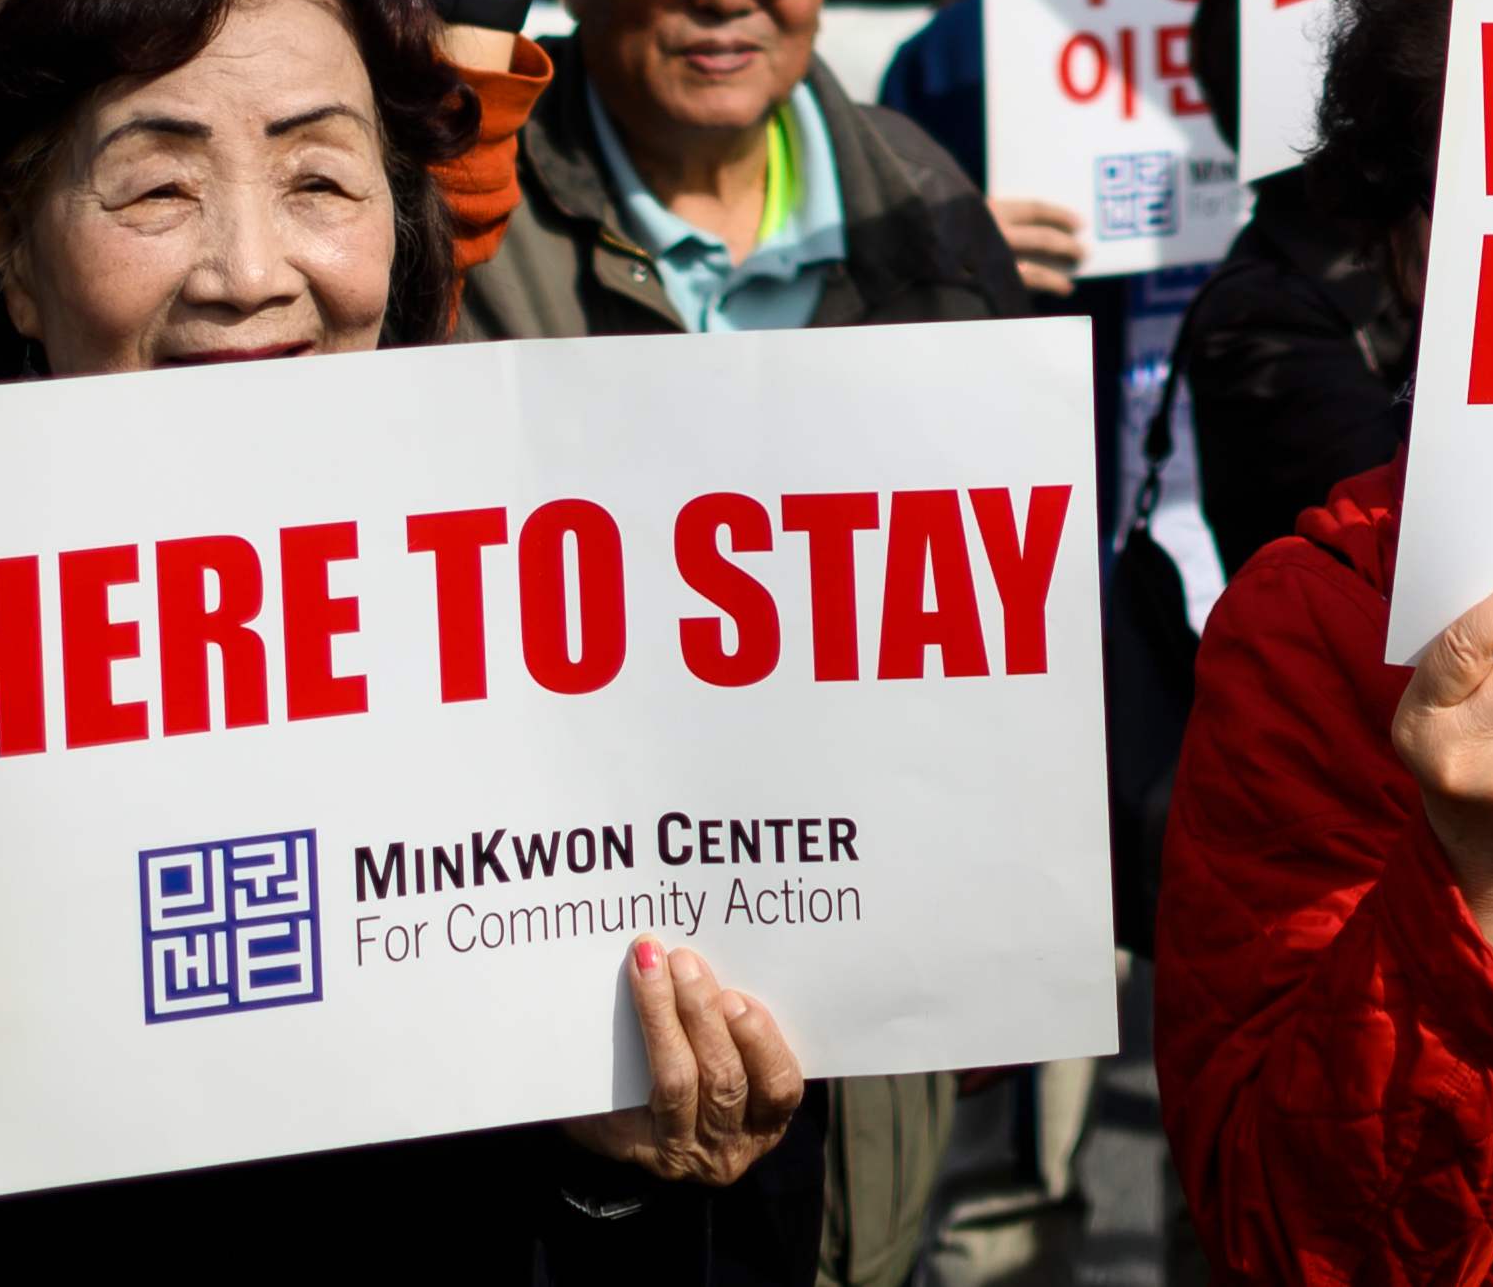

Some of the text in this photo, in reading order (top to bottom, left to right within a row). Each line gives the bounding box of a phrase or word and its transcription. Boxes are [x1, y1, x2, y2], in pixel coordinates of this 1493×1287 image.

[405, 496, 628, 704] TO
[672, 483, 1075, 689] STAY
[356, 876, 863, 967] For Community Action
